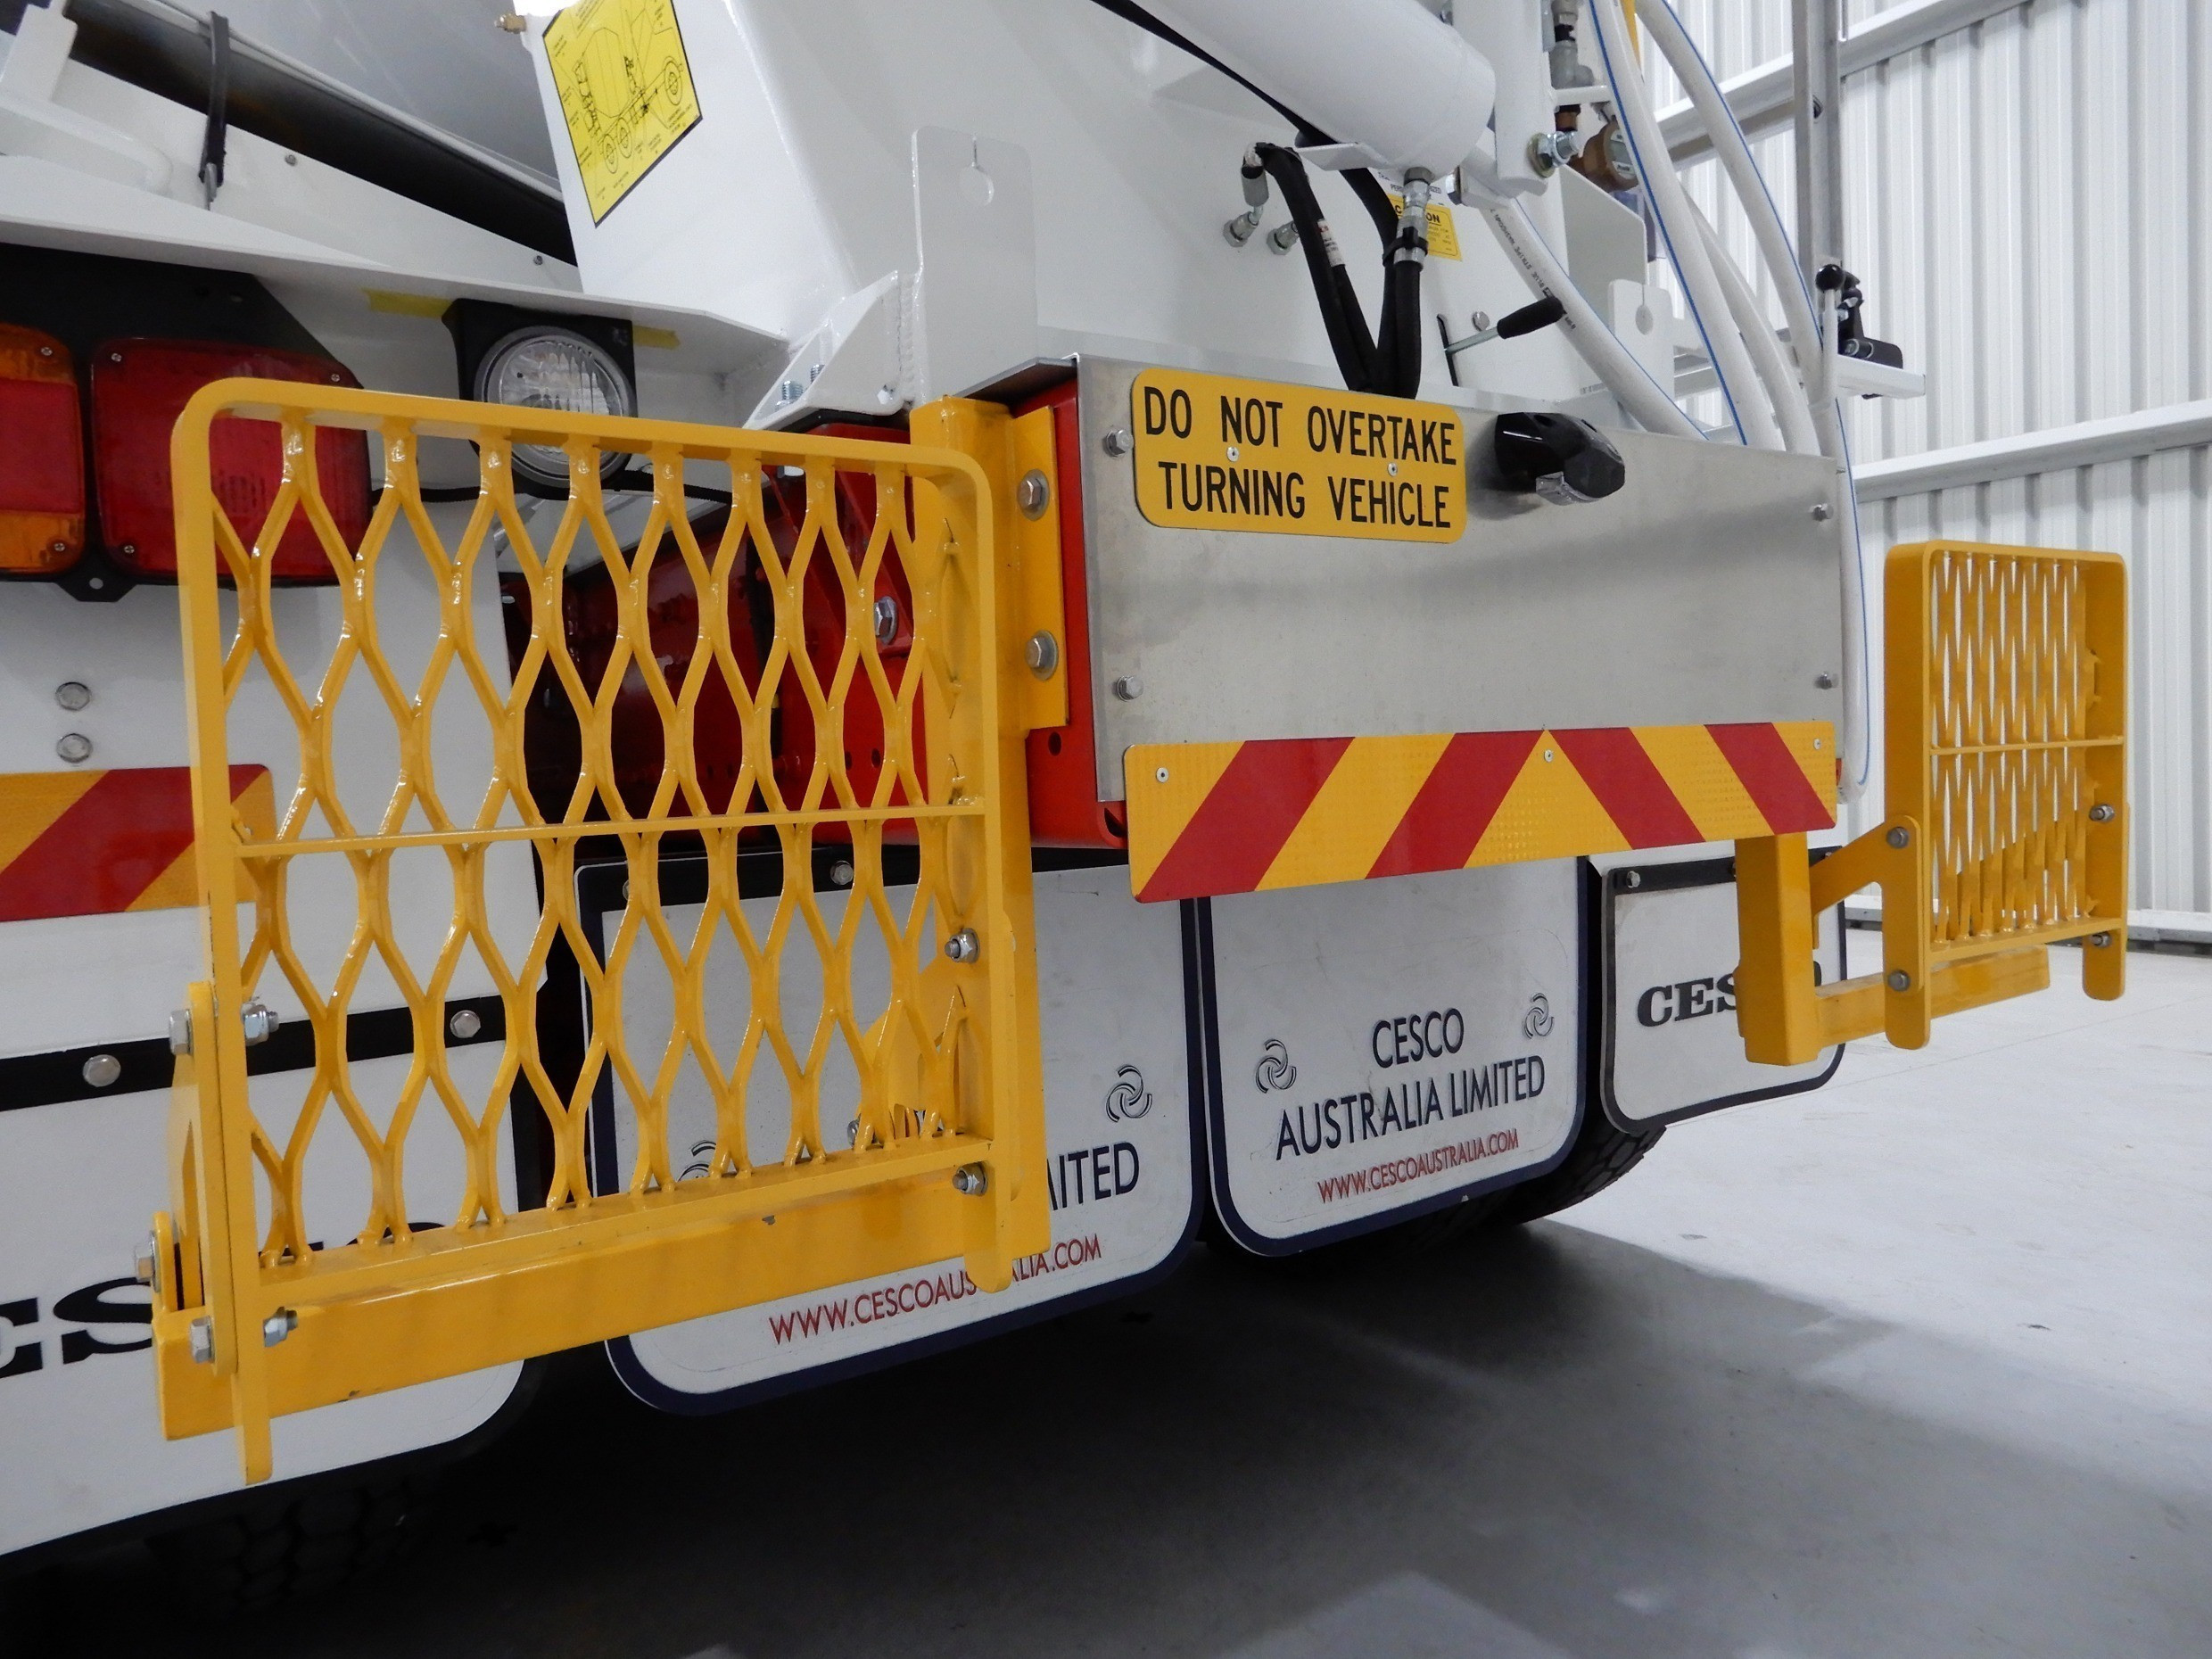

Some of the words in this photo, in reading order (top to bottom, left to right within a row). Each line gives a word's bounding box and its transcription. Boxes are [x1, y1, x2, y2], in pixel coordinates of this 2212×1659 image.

[1515, 246, 1532, 270] STRIPE
[1144, 386, 1192, 439] DO
[1220, 395, 1283, 447] NOT
[1308, 405, 1457, 465] OVERTAKE
[1159, 461, 1305, 519] TURNING
[1328, 475, 1451, 528] VEHICLE
[1372, 1008, 1464, 1069] CESCO
[1275, 1077, 1444, 1160] AUSTRALIA
[1449, 1055, 1545, 1118] LIMITED
[1046, 1142, 1140, 1211] ITED
[1317, 1128, 1519, 1203] WWW.CESCOAUSTRALIA.COM
